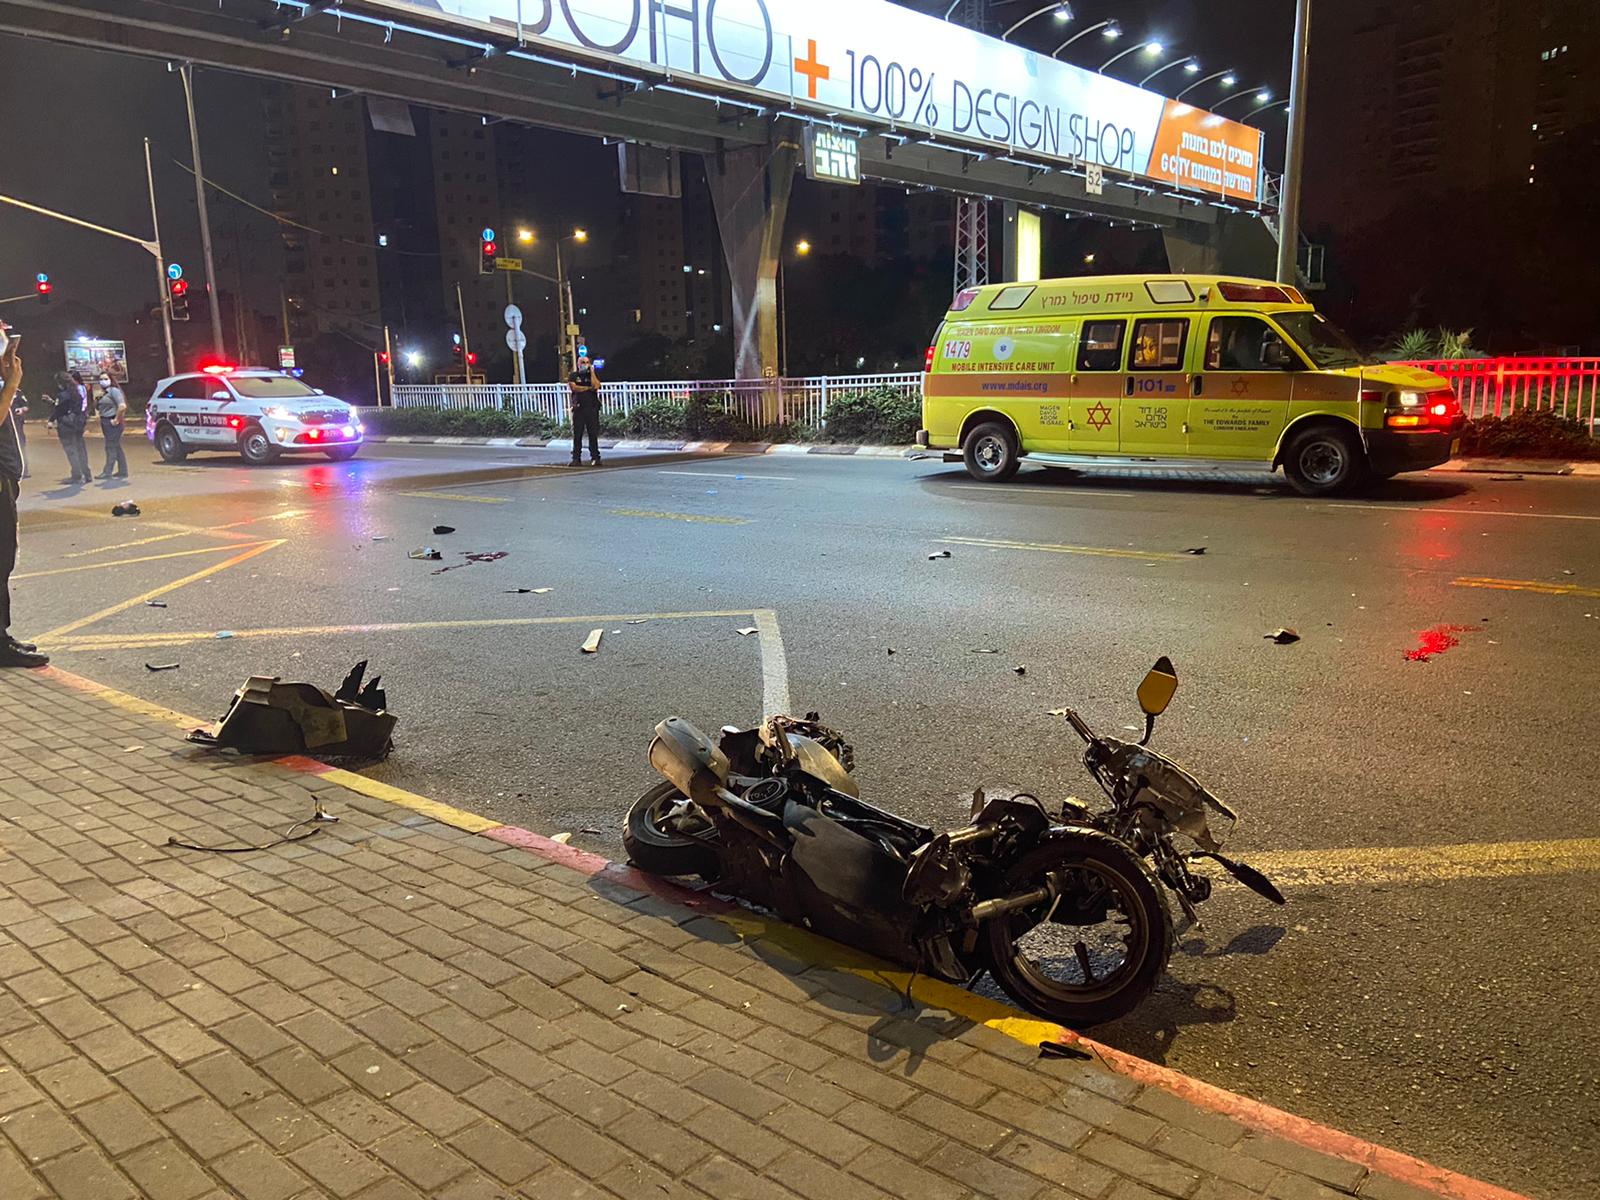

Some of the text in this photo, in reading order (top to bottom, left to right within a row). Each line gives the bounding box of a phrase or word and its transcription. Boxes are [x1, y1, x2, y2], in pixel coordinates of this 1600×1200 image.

[490, 0, 773, 87] HO
[846, 49, 938, 127] 100%
[953, 79, 1061, 156] DESIGN
[1068, 112, 1134, 169] SHOP
[1181, 131, 1254, 169] מחכים לכם בחנות
[815, 149, 857, 180] זהב
[1191, 161, 1223, 186] במתחם
[1224, 171, 1252, 193] החדשה
[1041, 290, 1134, 309] ניידת טיפול נמרץ
[945, 341, 971, 358] 1479
[951, 361, 1055, 371] MOBILE INTENSIVE CARE UNIT
[981, 380, 1048, 392] www.mdais.org
[1137, 379, 1163, 392] 101
[176, 413, 228, 425] משטרת ישראל
[1135, 419, 1167, 429] בישראל
